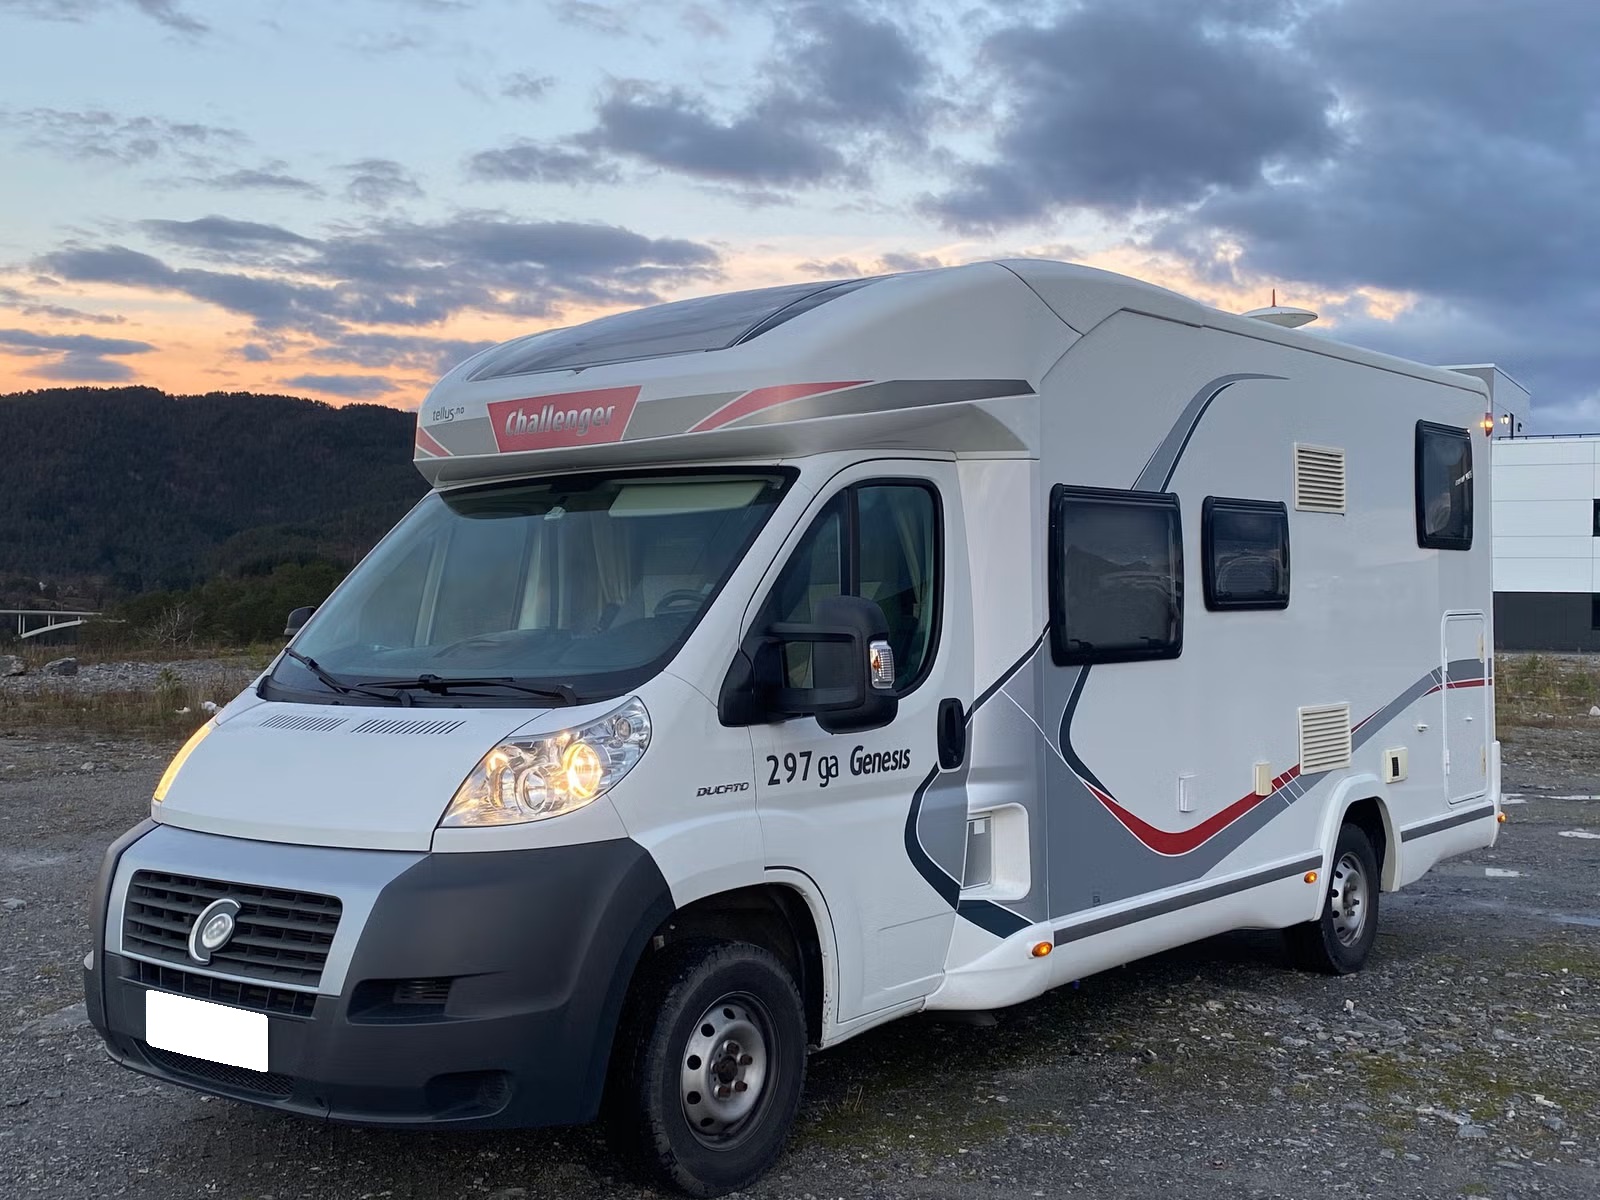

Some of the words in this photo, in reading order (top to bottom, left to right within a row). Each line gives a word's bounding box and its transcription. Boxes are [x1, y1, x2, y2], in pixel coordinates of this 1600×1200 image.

[505, 404, 616, 436] Challenger
[766, 750, 813, 786] 297
[817, 755, 839, 788] ga
[850, 745, 911, 776] Genesis
[696, 782, 750, 797] DUCATO
